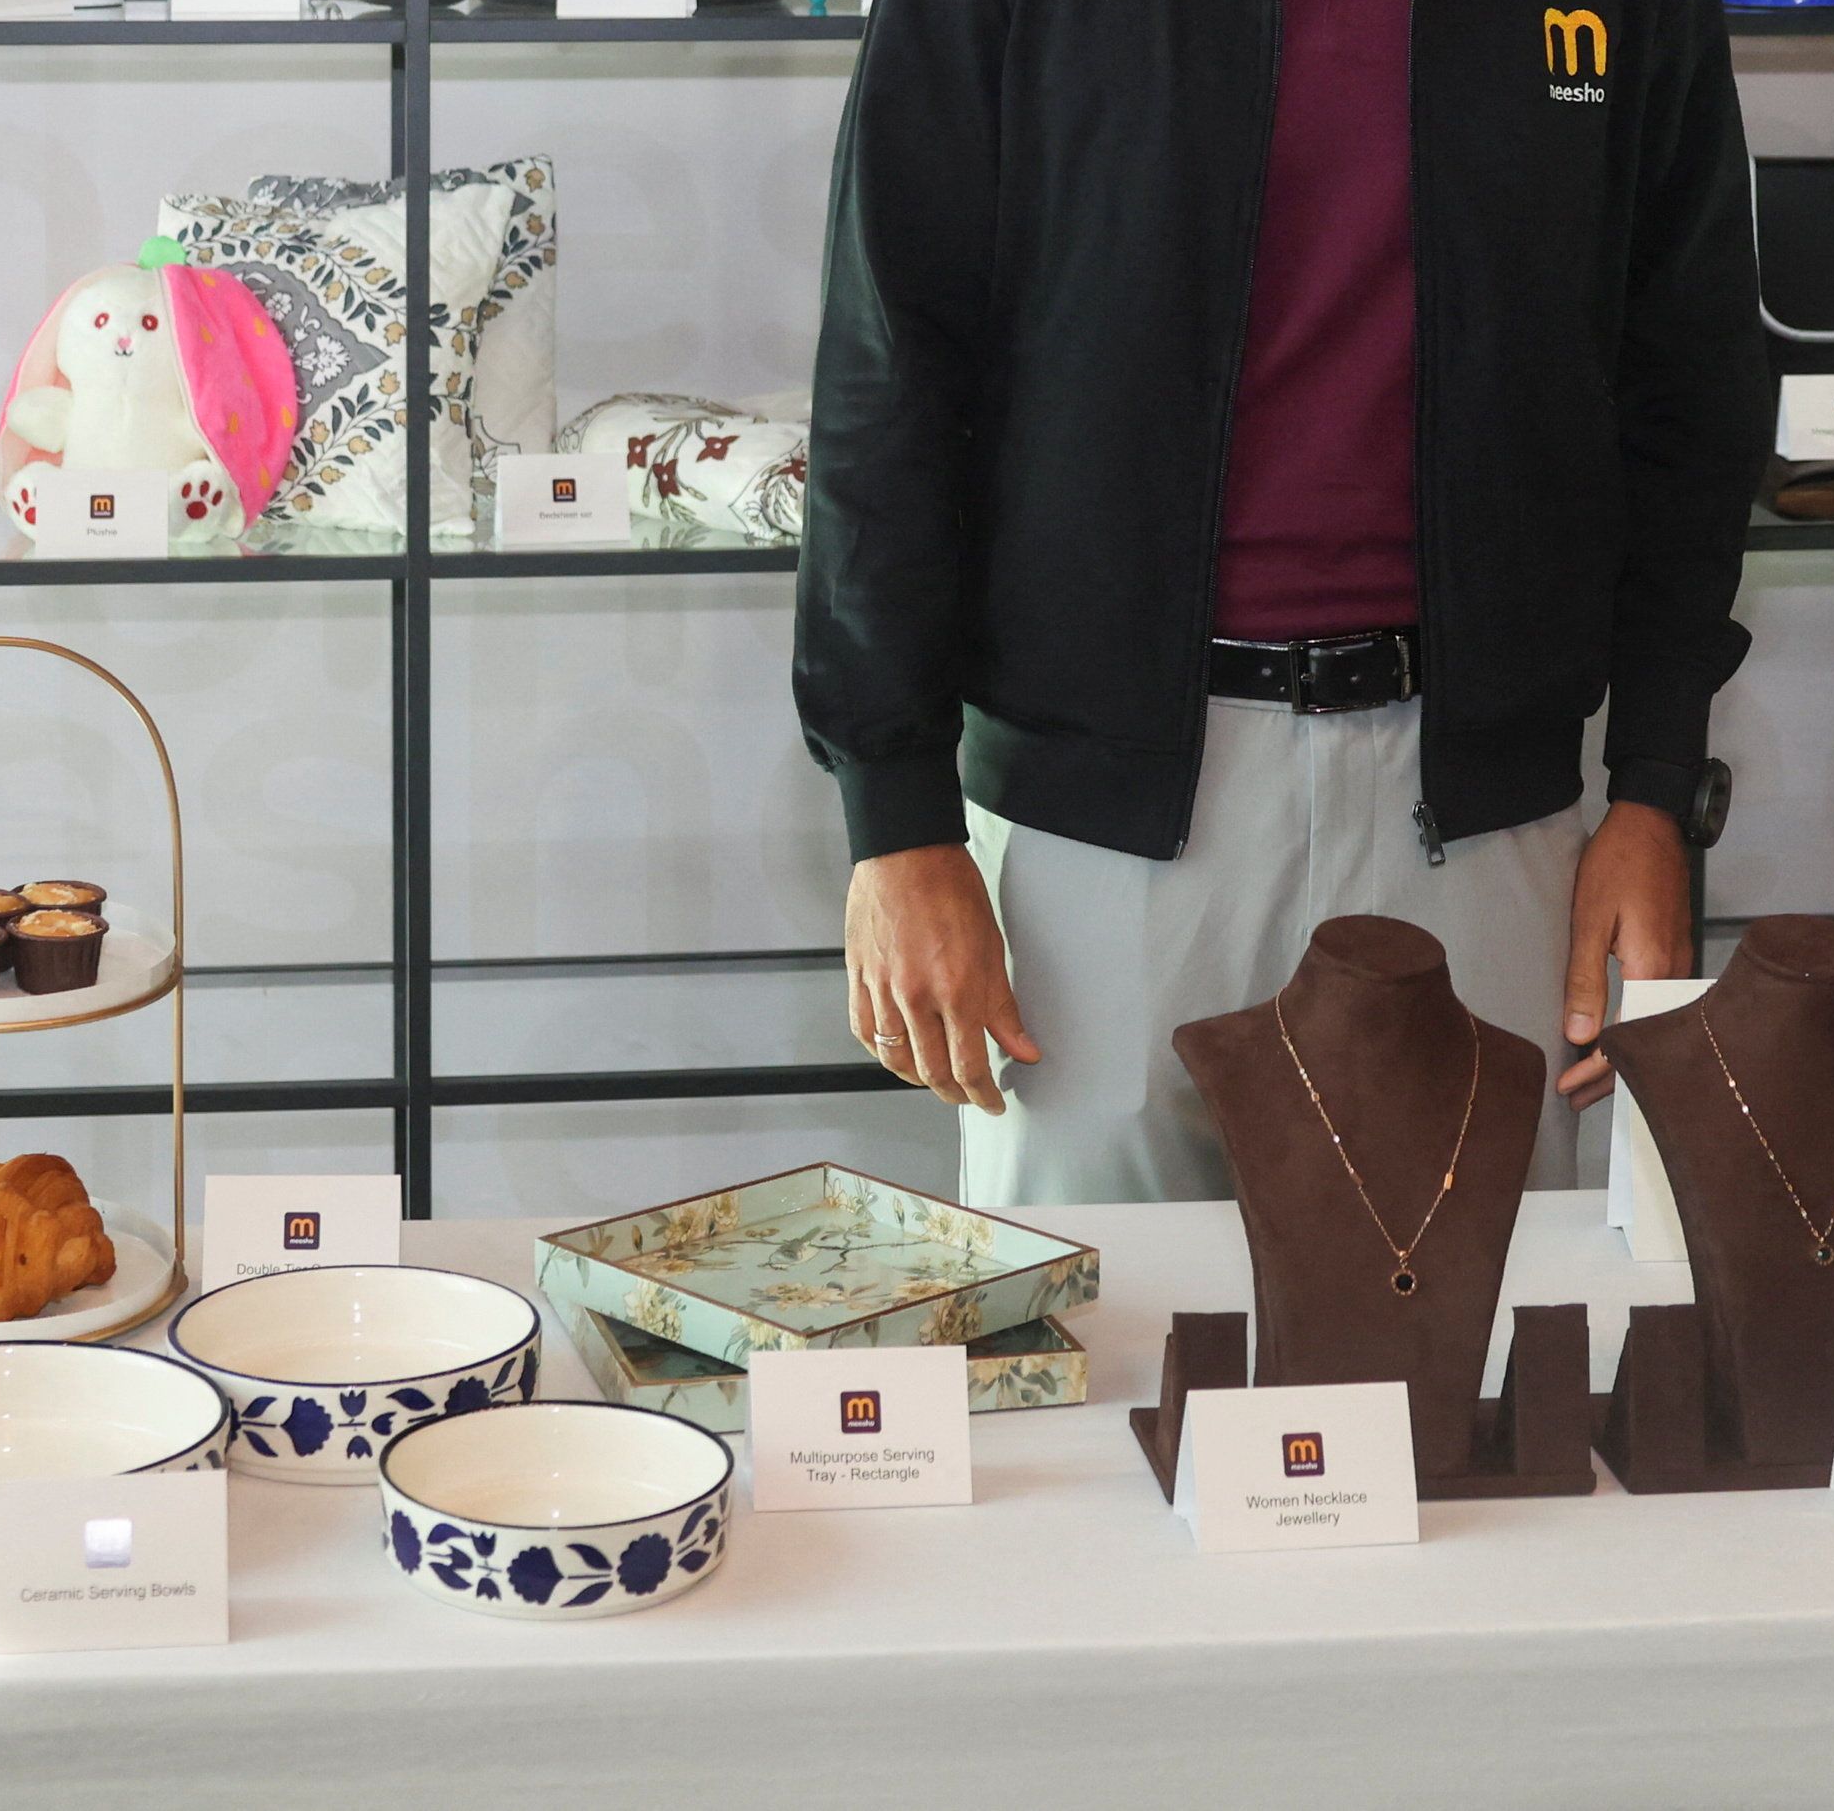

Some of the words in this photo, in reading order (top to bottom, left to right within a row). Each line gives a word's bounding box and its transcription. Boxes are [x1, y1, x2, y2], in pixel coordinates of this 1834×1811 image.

[237, 1263, 280, 1276] Double
[790, 1450, 878, 1465] Multipurpose
[883, 1448, 935, 1463] Serving
[806, 1468, 837, 1483] Tray
[850, 1466, 920, 1482] Rectangle
[1246, 1494, 1300, 1509] Women
[1304, 1491, 1367, 1507] Necklace
[1276, 1512, 1340, 1527] Jewellery
[21, 1585, 84, 1602] Ceramic
[88, 1583, 146, 1602] Serving
[151, 1580, 196, 1598] Bowls
